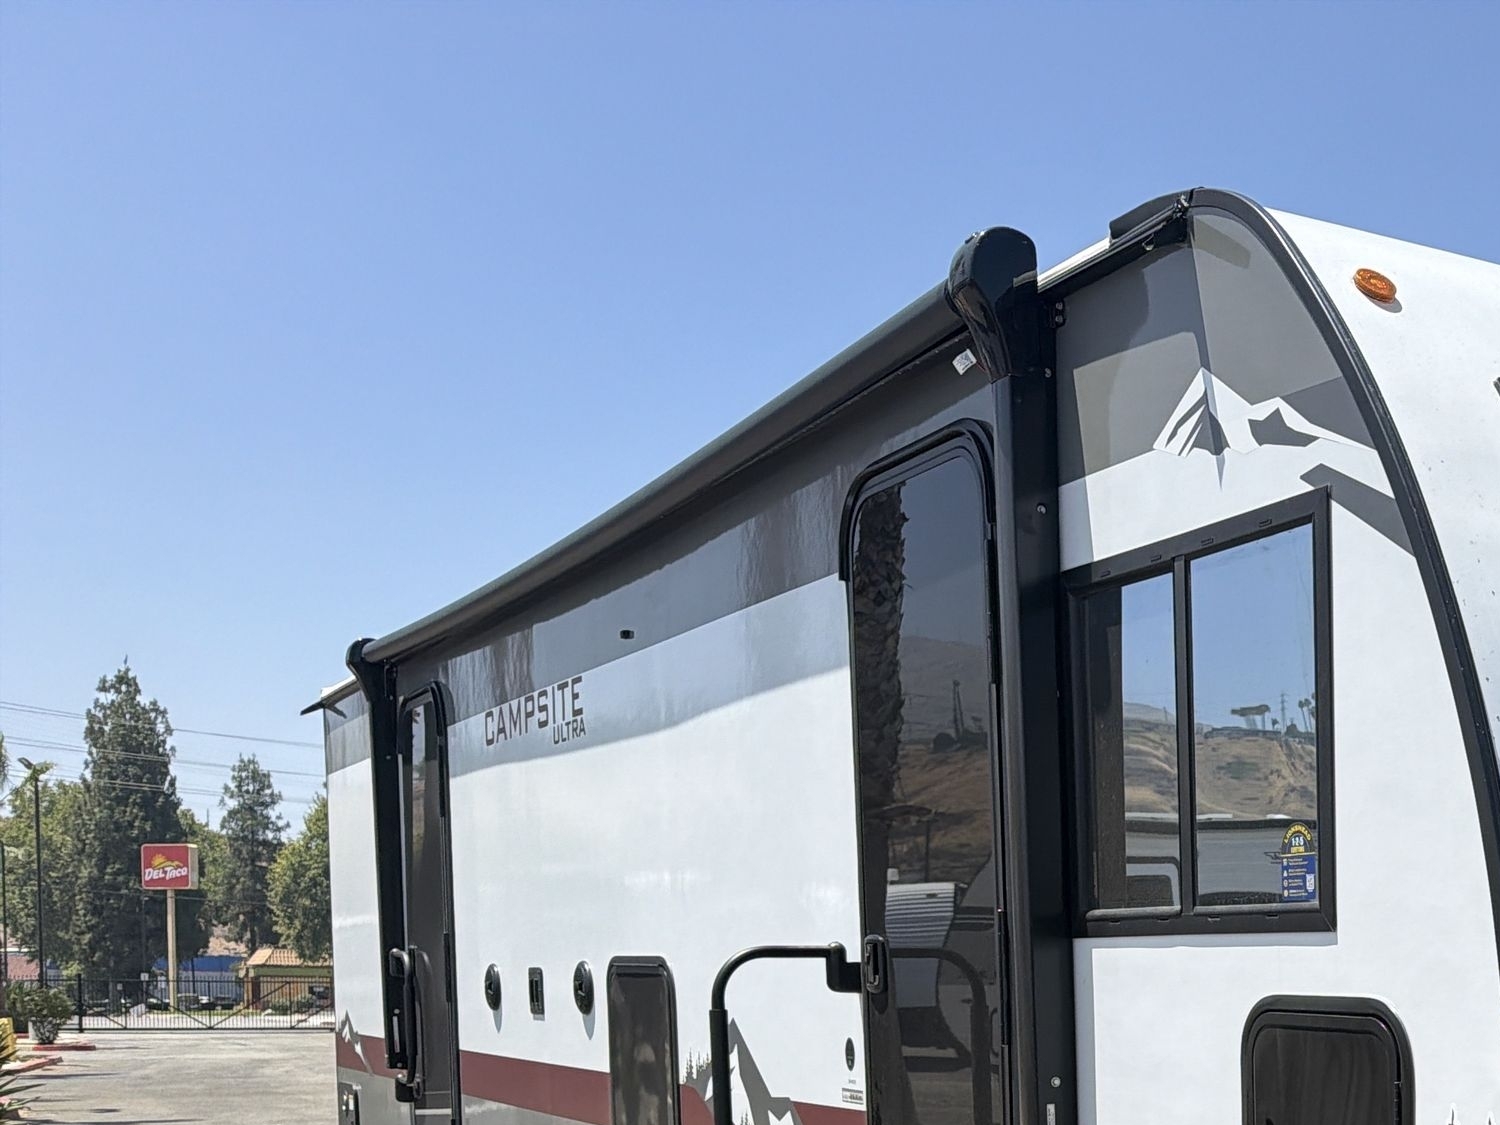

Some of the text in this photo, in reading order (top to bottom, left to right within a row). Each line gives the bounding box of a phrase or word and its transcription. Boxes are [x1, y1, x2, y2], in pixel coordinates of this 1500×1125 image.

[485, 675, 584, 747] CAMPSITE
[553, 717, 586, 745] ULTRA
[144, 866, 188, 881] DEL TACO
